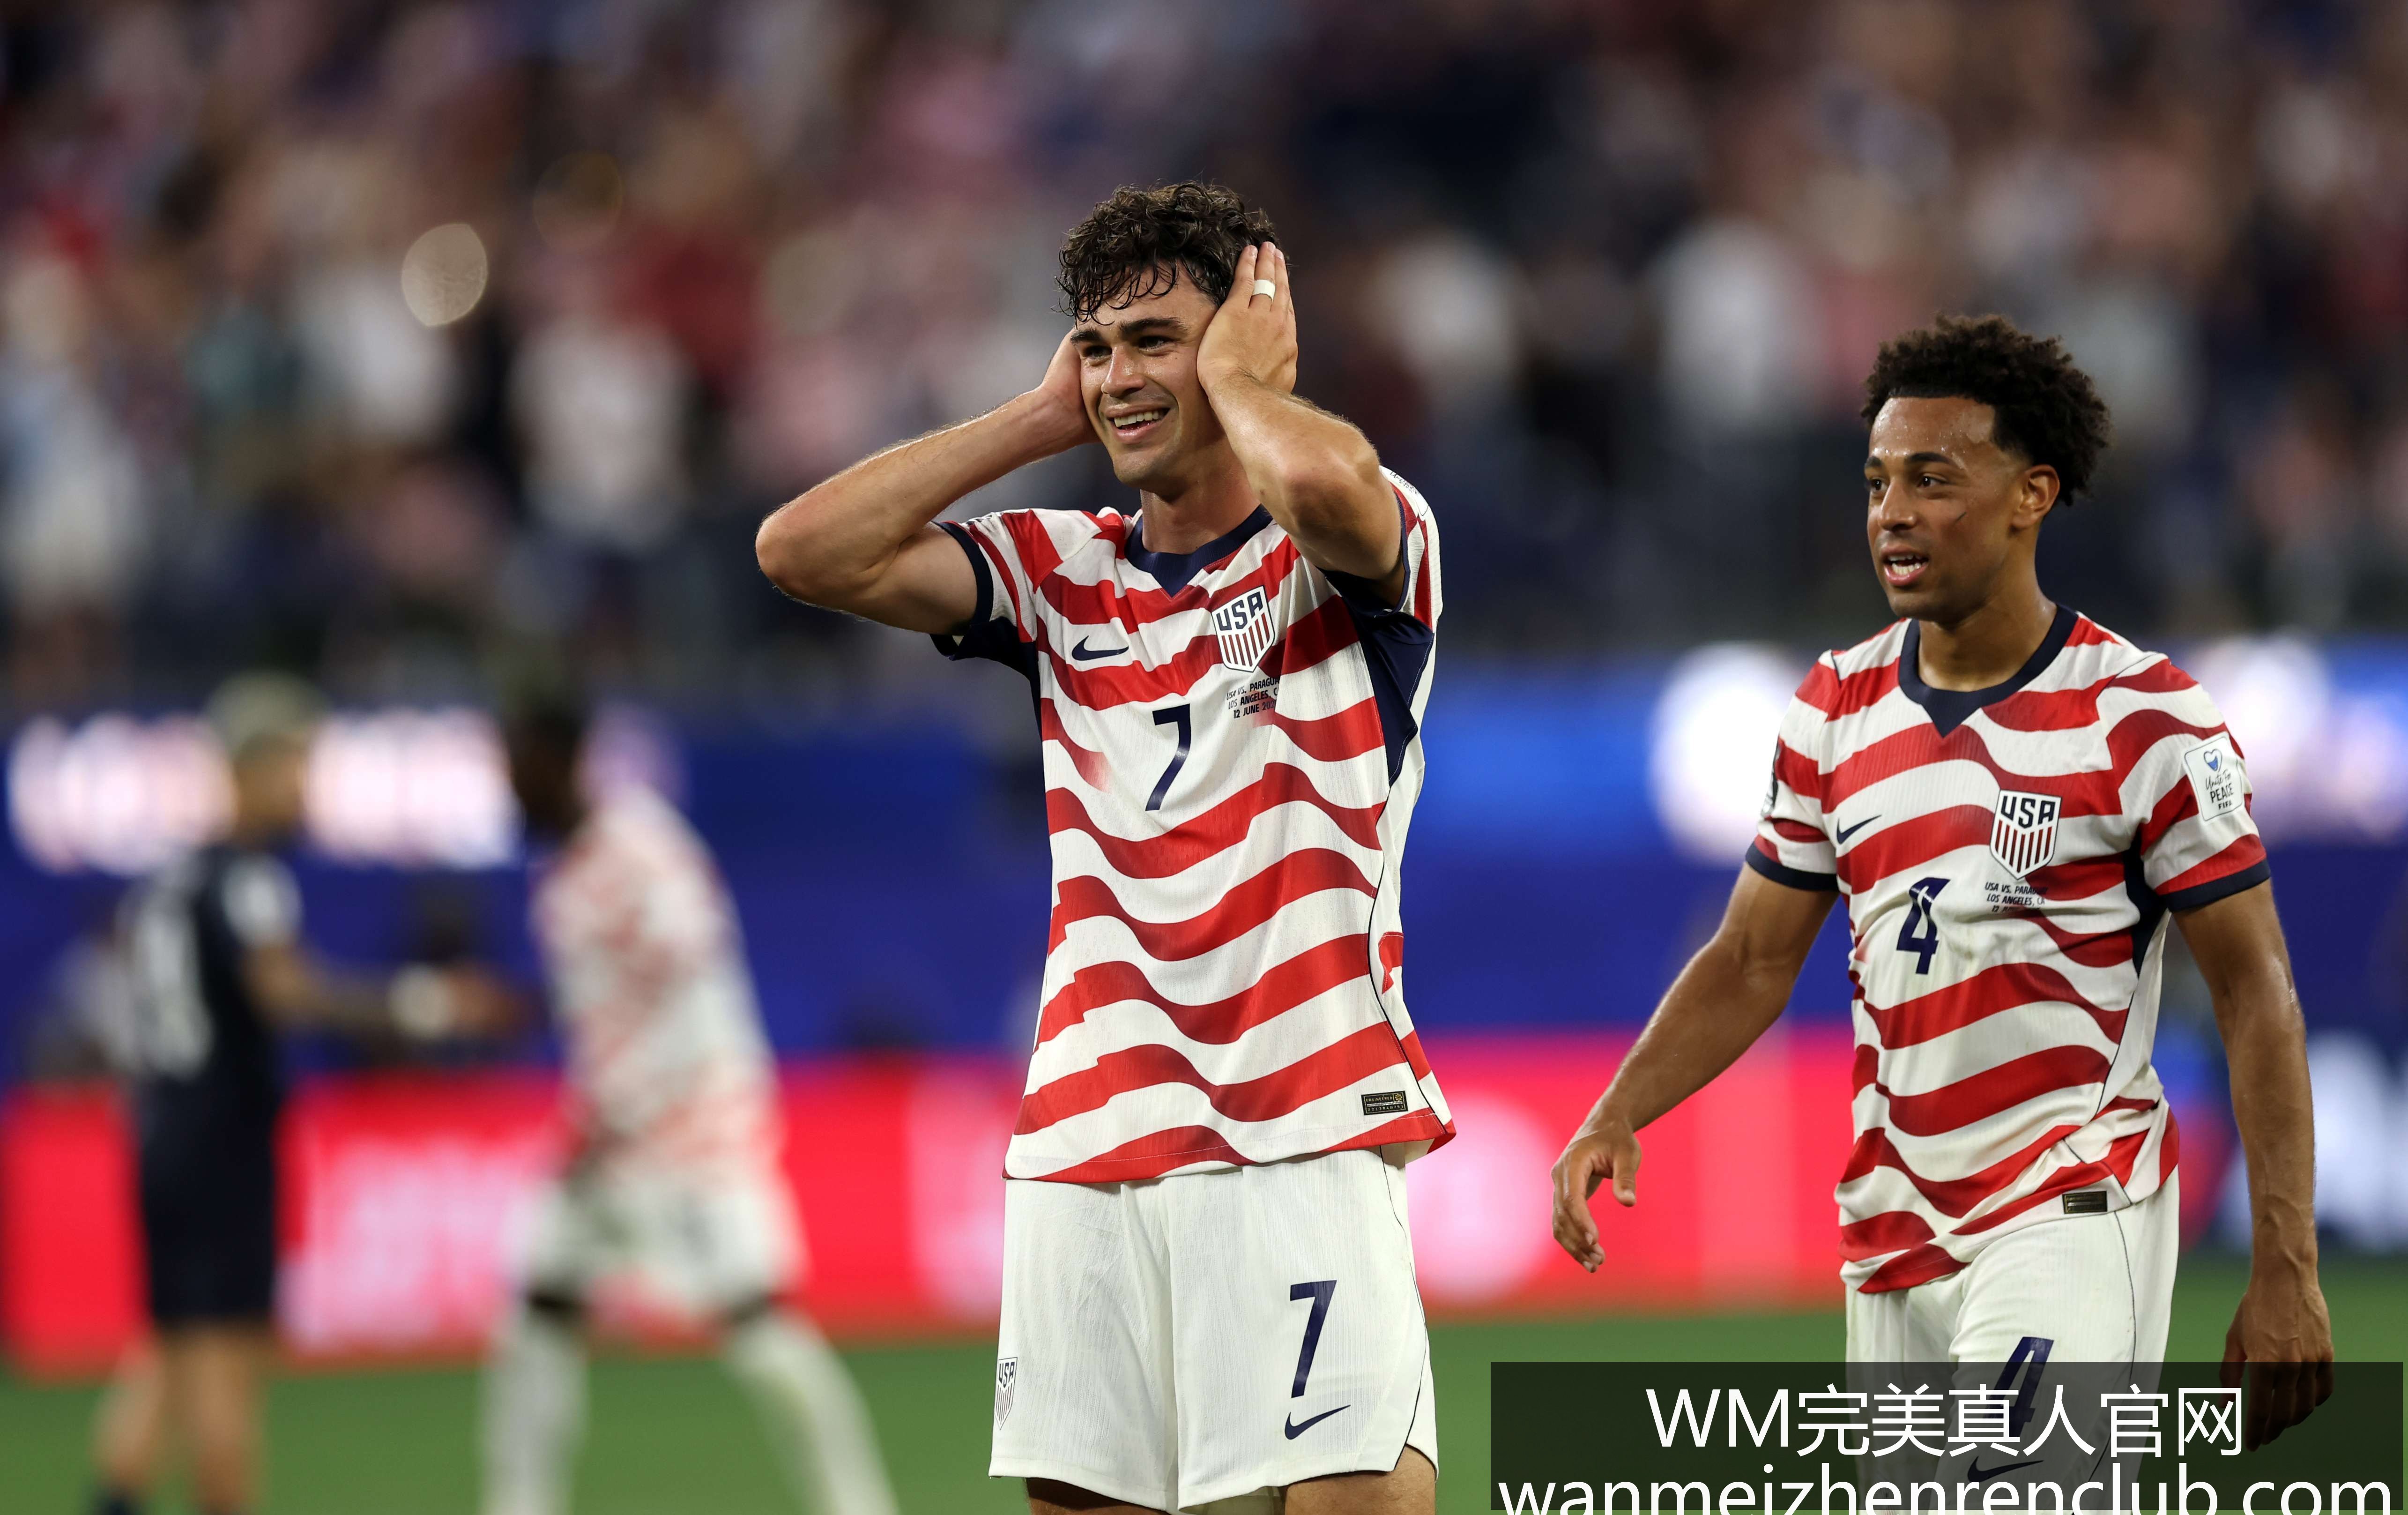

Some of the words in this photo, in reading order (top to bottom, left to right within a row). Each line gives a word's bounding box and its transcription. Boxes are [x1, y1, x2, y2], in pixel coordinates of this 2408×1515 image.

[1216, 591, 1263, 631] USA
[1226, 690, 1236, 700] USA
[1238, 686, 1246, 694] VS.
[1249, 678, 1279, 692] PARAGUA
[1228, 699, 1238, 709] LOS
[1234, 709, 1240, 718] 12
[1243, 704, 1259, 716] JUNE
[1262, 700, 1276, 710] 202
[1145, 703, 1190, 811] 7
[2210, 783, 2234, 803] PEACE
[2000, 795, 2056, 828] USA
[1985, 882, 1999, 891] USA
[2001, 884, 2012, 894] VS.
[1987, 894, 2000, 903] LOS
[1896, 877, 1950, 975] 4
[1290, 1280, 1337, 1398] 7
[999, 1362, 1015, 1388] USA
[1983, 1336, 2054, 1441] 4
